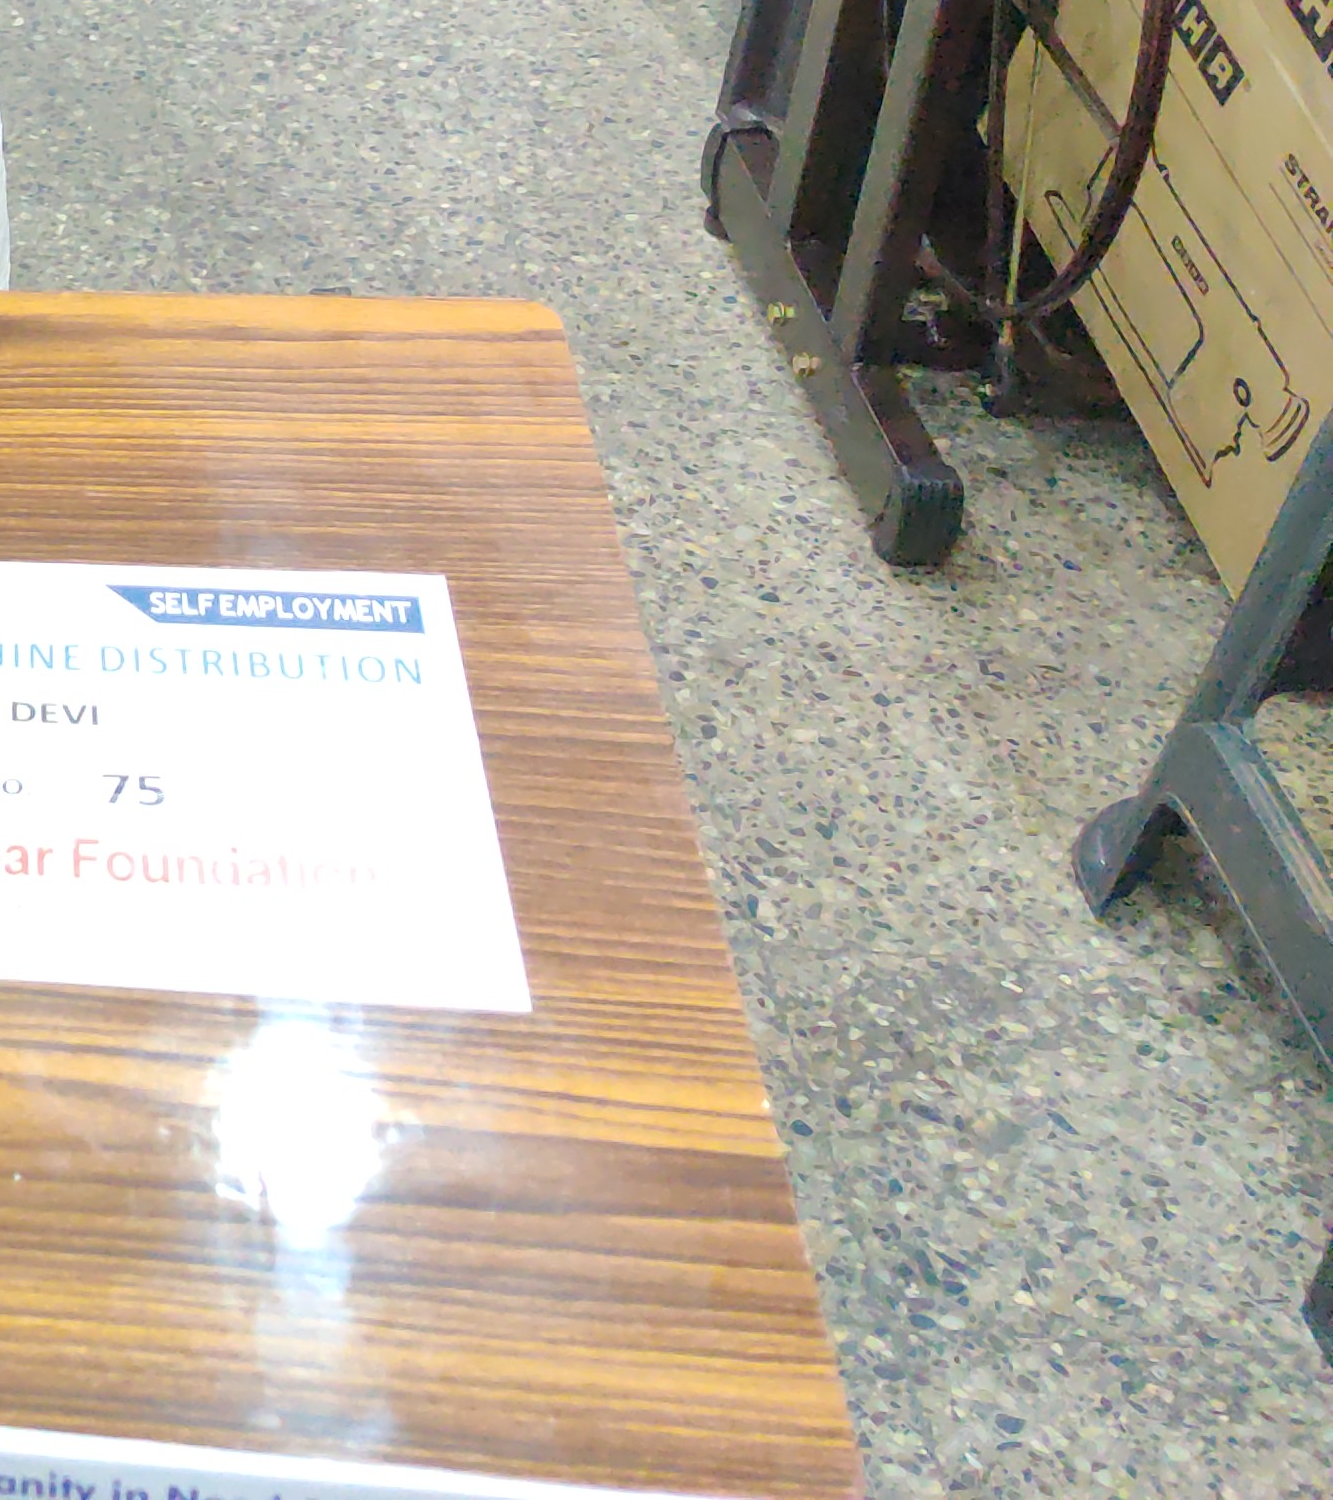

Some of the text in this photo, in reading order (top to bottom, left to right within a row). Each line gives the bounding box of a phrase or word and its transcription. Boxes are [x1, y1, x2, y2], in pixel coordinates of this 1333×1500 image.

[148, 591, 412, 624] SELF EMPLOYMENT
[100, 644, 423, 685] DISTRIBUTION
[10, 700, 100, 726] DEVI
[101, 773, 166, 806] 75
